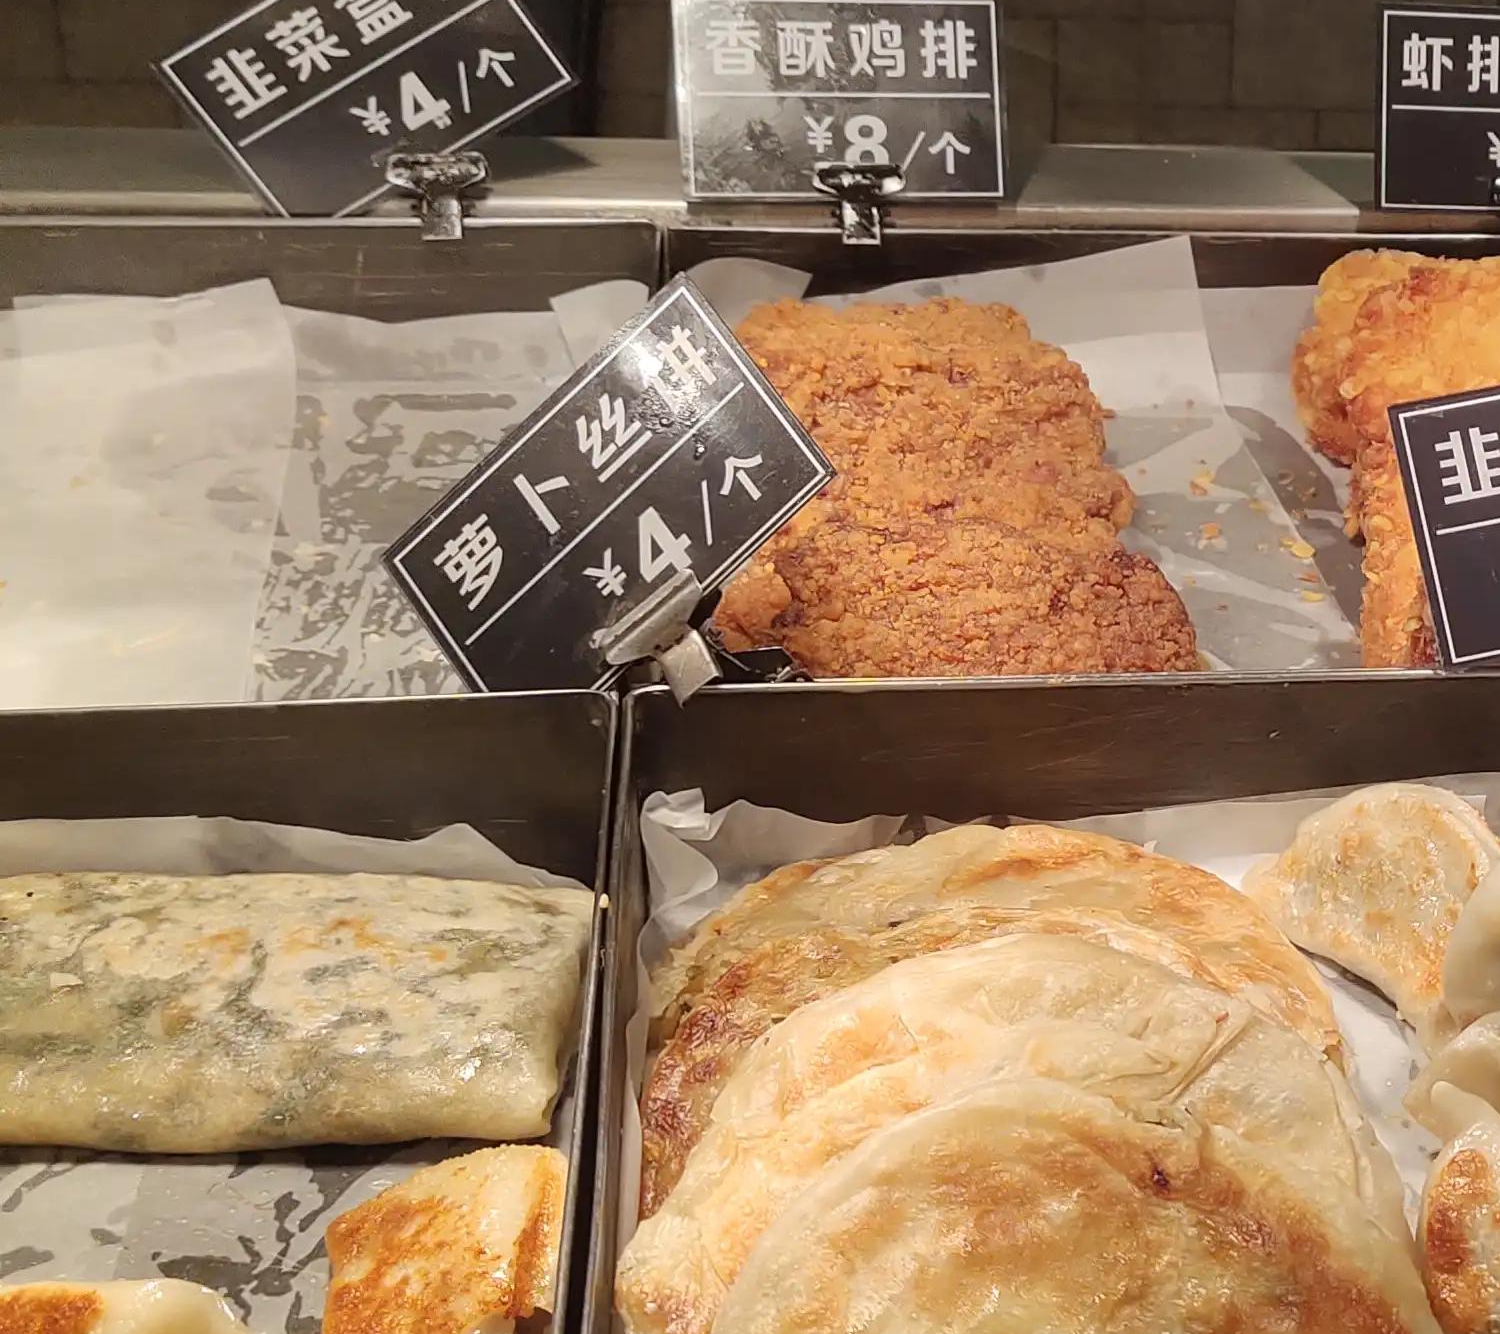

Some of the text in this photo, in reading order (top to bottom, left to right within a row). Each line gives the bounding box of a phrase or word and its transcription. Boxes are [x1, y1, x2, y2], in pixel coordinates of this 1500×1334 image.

[349, 48, 515, 136] ¥4/个
[705, 19, 978, 79] 香酥鸡排
[582, 454, 763, 597] ¥4/个
